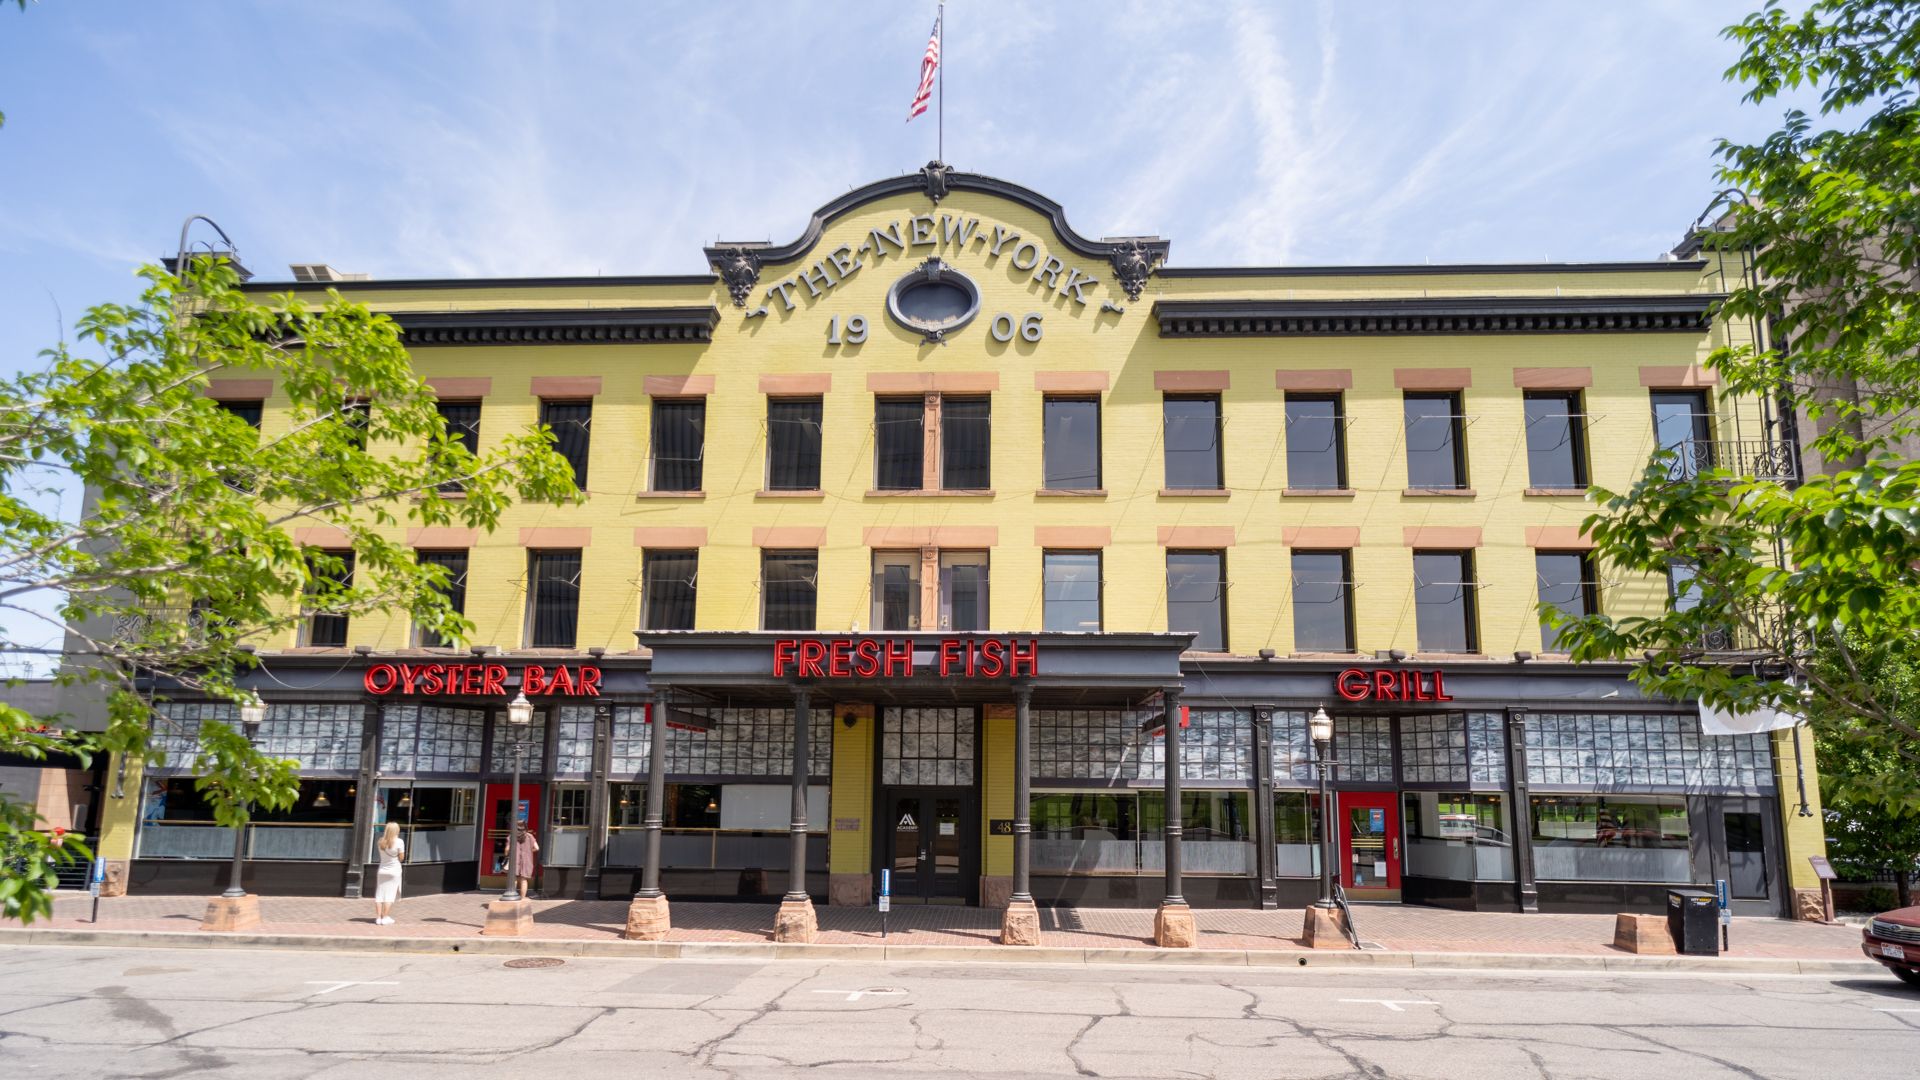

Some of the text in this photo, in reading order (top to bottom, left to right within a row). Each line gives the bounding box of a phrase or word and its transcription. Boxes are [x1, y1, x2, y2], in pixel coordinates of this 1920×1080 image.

[767, 214, 1099, 311] THE NEW YORK
[828, 312, 1044, 345] 19 06
[773, 638, 1038, 678] FRESH FISH
[364, 663, 602, 696] OYSTER BAR
[1336, 668, 1454, 702] GRILL
[997, 822, 1012, 833] 48
